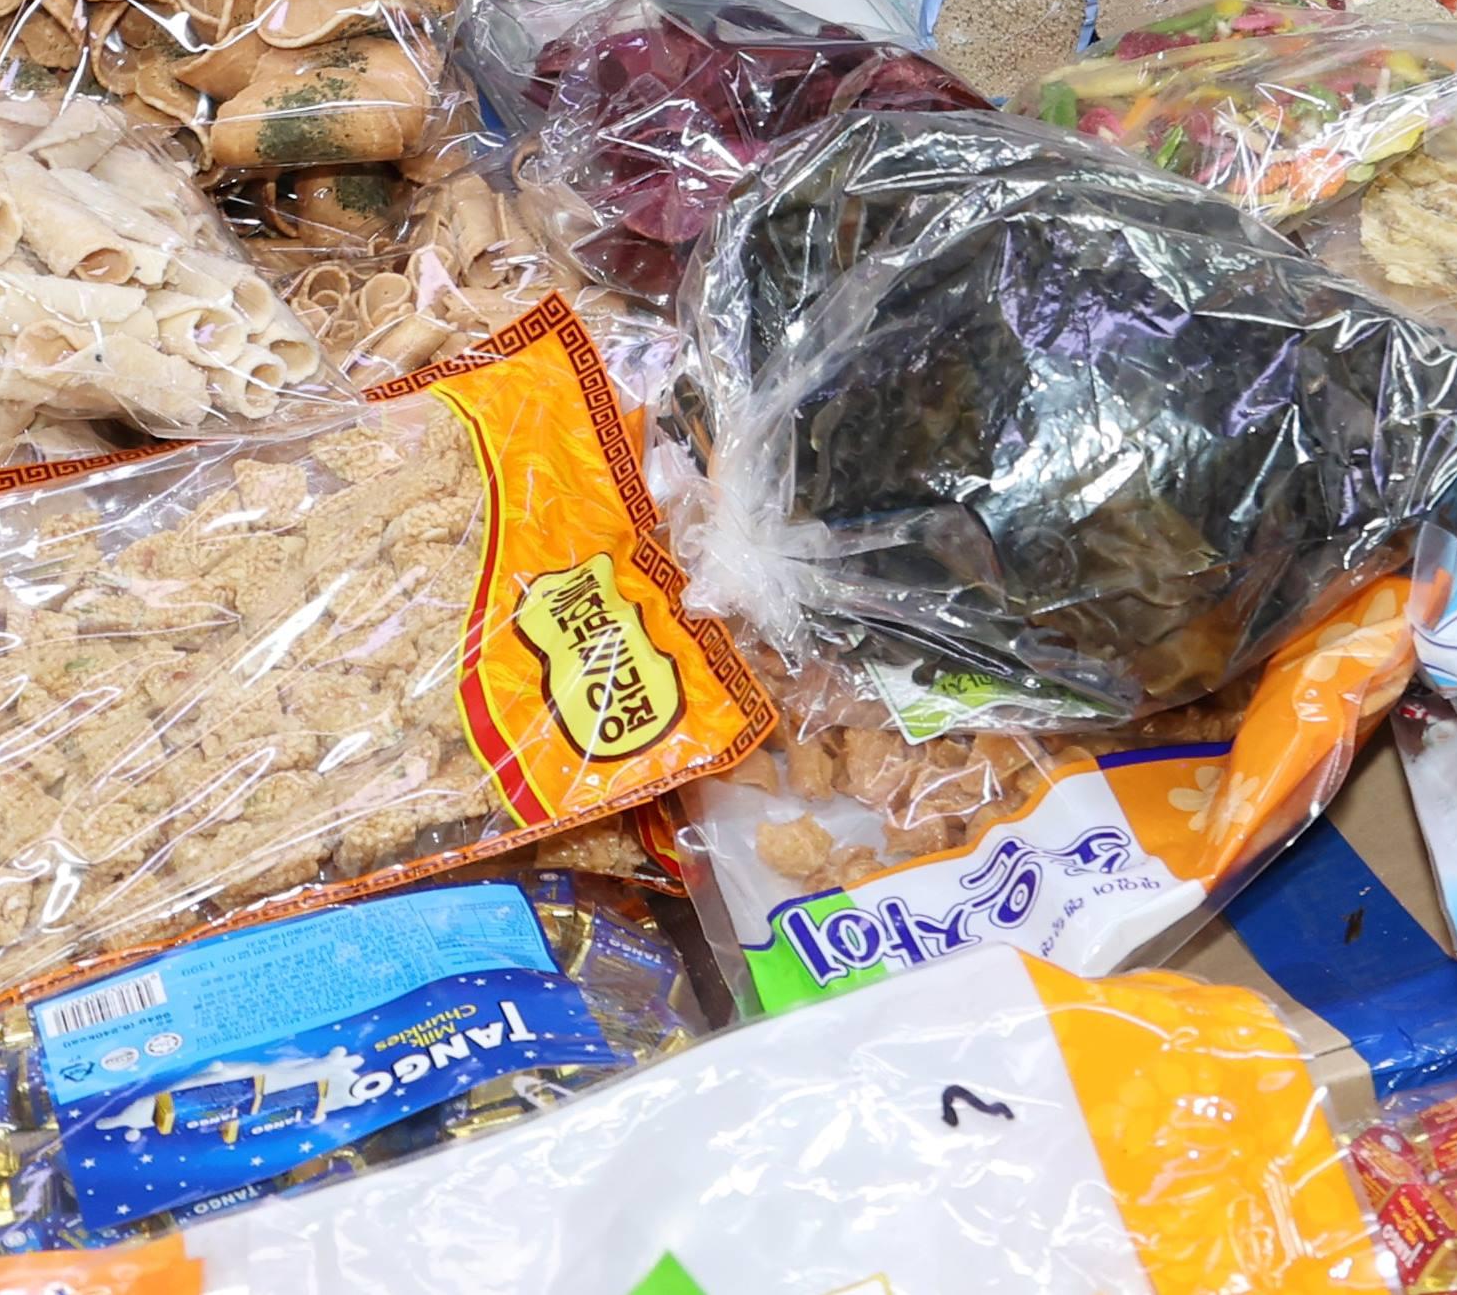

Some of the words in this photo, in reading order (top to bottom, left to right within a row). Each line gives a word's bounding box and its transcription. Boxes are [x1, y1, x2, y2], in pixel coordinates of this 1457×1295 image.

[347, 998, 536, 1103] TANGO
[374, 1002, 477, 1053] Chunkies
[408, 1021, 456, 1050] Milk
